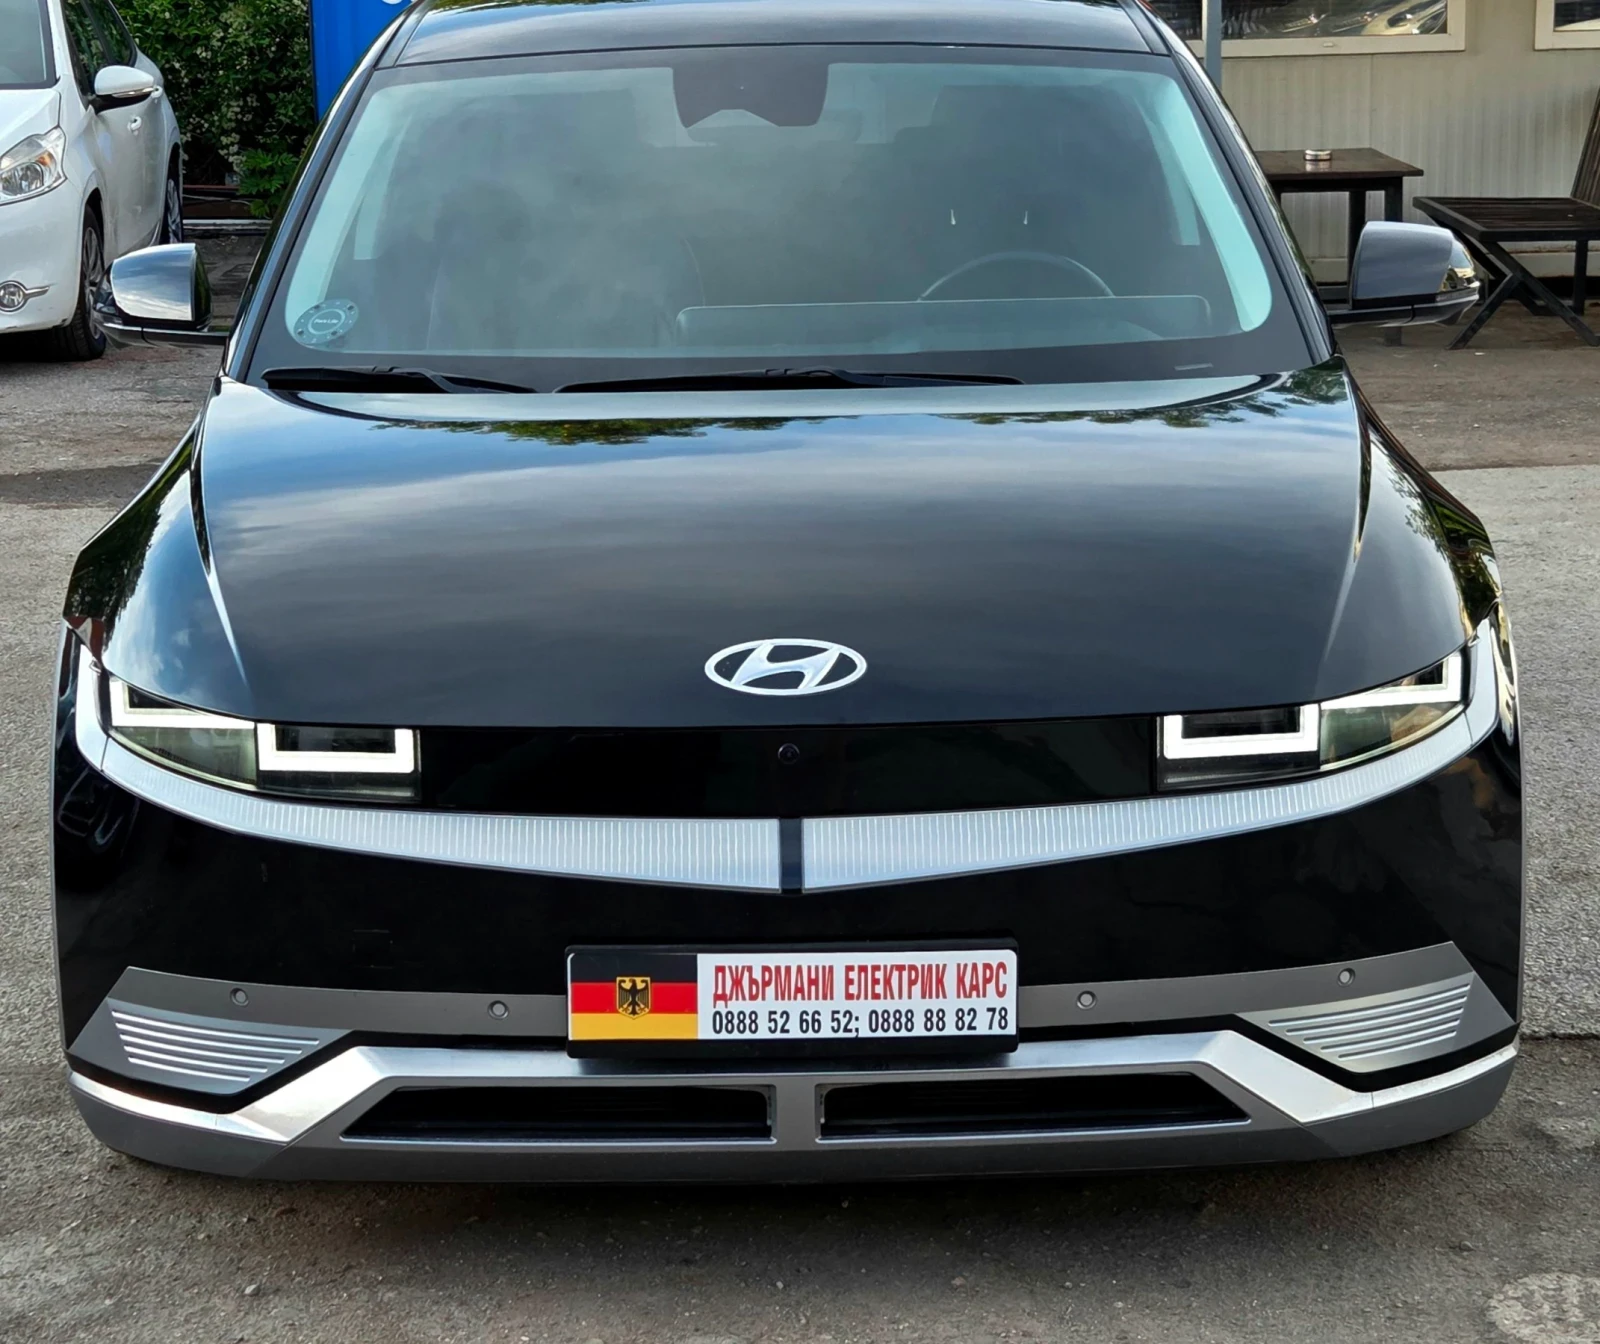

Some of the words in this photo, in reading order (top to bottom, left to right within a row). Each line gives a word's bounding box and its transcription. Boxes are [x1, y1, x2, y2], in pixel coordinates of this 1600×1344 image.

[713, 965, 834, 1008] ДЖЪРМАНИ
[844, 963, 947, 1001] ЕЛЕКТРИК
[956, 961, 1007, 999] КАРС
[712, 1010, 759, 1034] 0888
[768, 1010, 791, 1034] 52
[799, 1010, 822, 1034] 66
[831, 1010, 860, 1038] 52;
[868, 1009, 915, 1033] 0888
[924, 1008, 946, 1032] 88
[955, 1007, 978, 1032] 82
[986, 1006, 1009, 1031] 78
